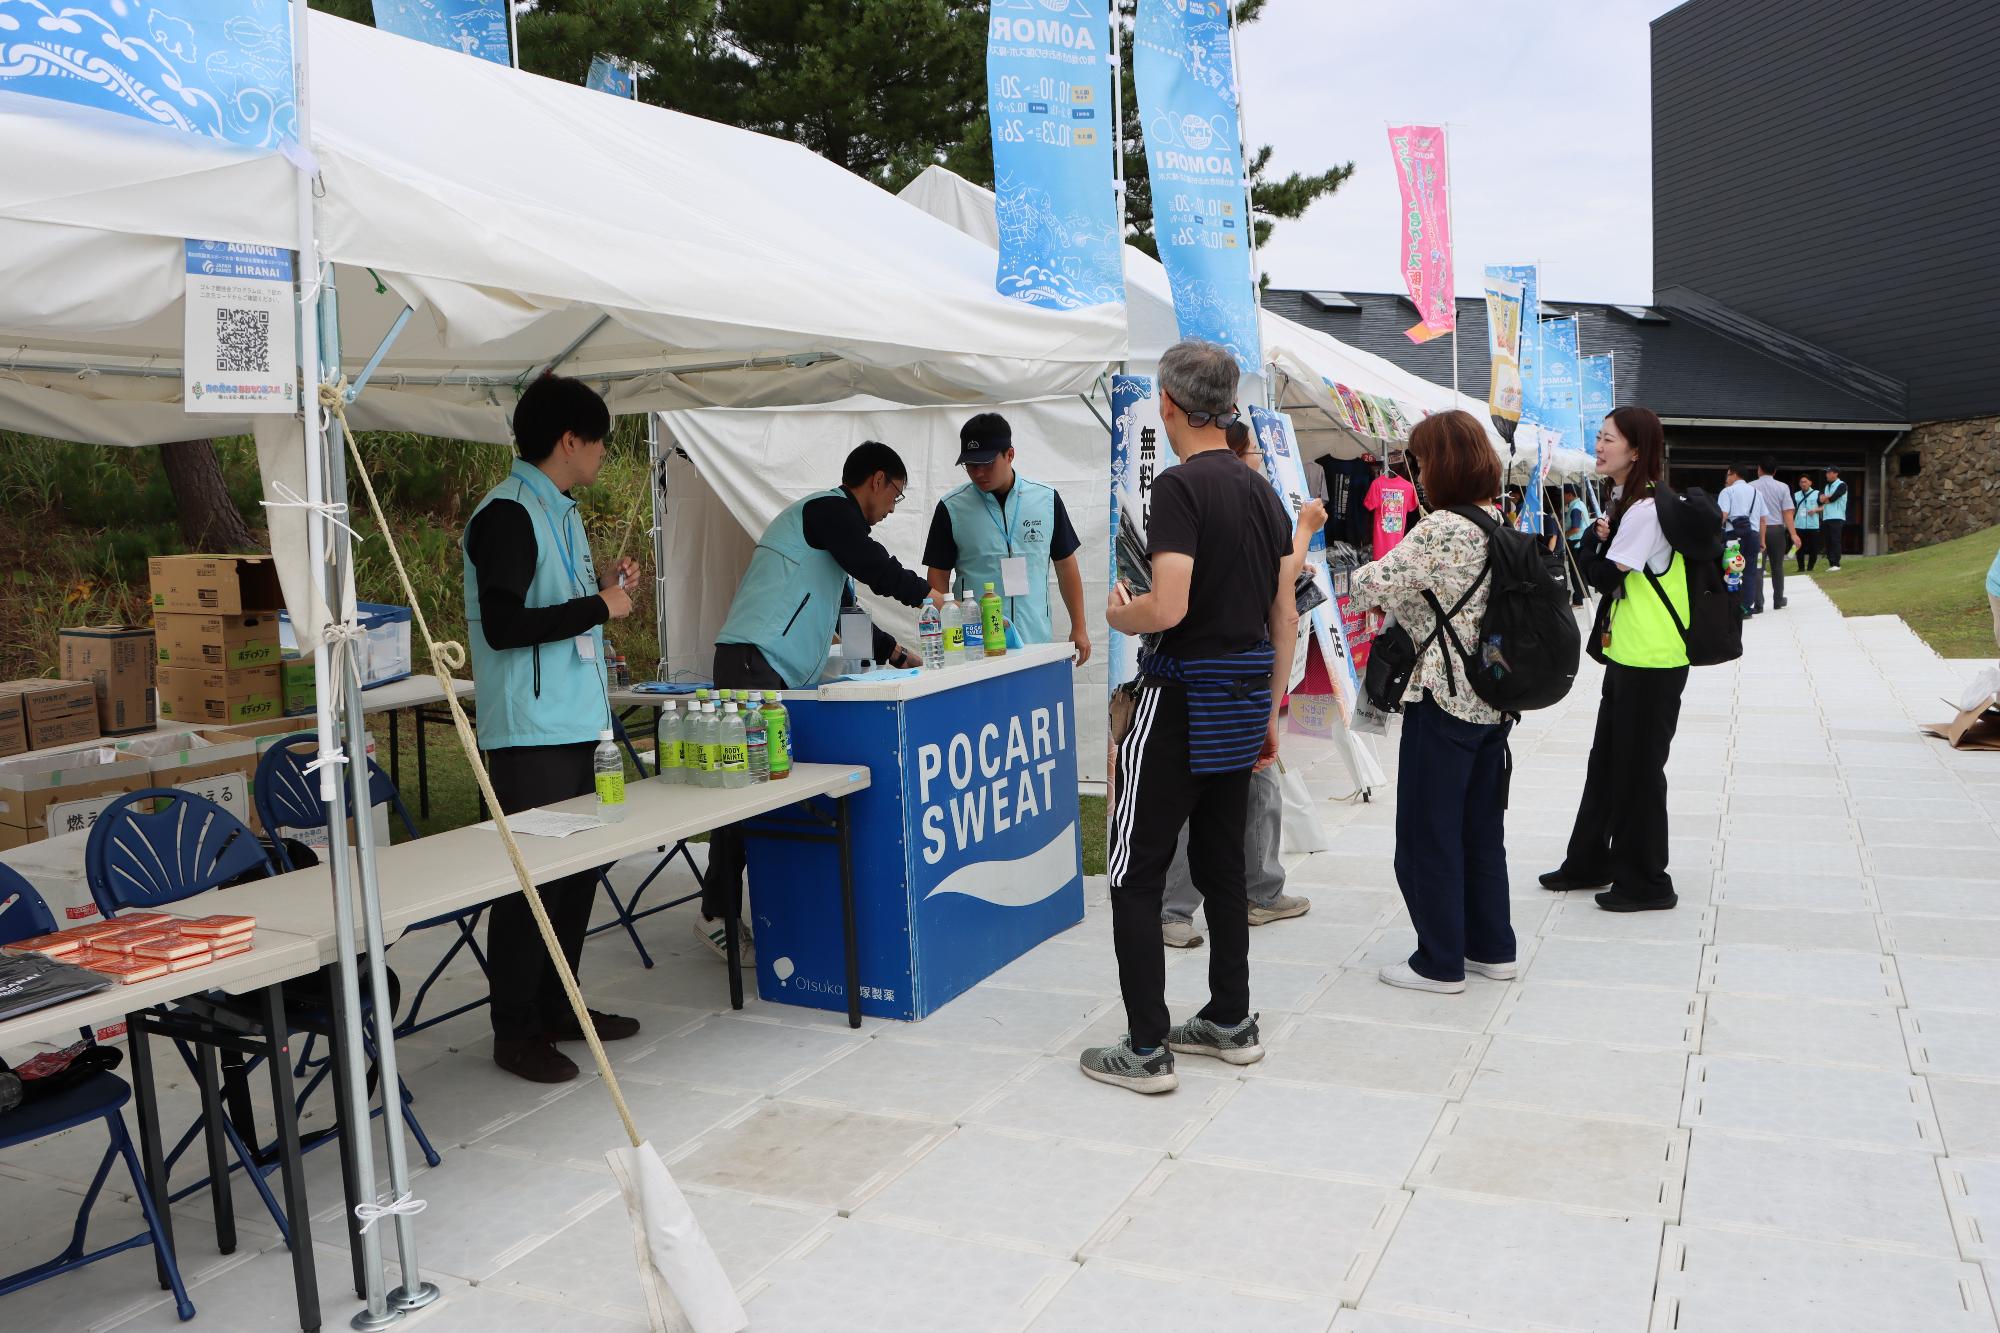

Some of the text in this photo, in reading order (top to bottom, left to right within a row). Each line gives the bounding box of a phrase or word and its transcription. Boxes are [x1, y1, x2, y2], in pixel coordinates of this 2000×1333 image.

[235, 265, 280, 278] HIRANAI
[238, 648, 270, 661] ボディメンテ
[240, 702, 272, 715] ボディメンテ
[722, 752, 744, 761] MAINTE
[918, 702, 1066, 804] POCARI
[198, 786, 233, 803] える
[922, 758, 1056, 865] SWEAT
[66, 811, 98, 833] 燃え
[795, 976, 843, 996] Otsuka
[859, 985, 895, 1002] 塚製薬
